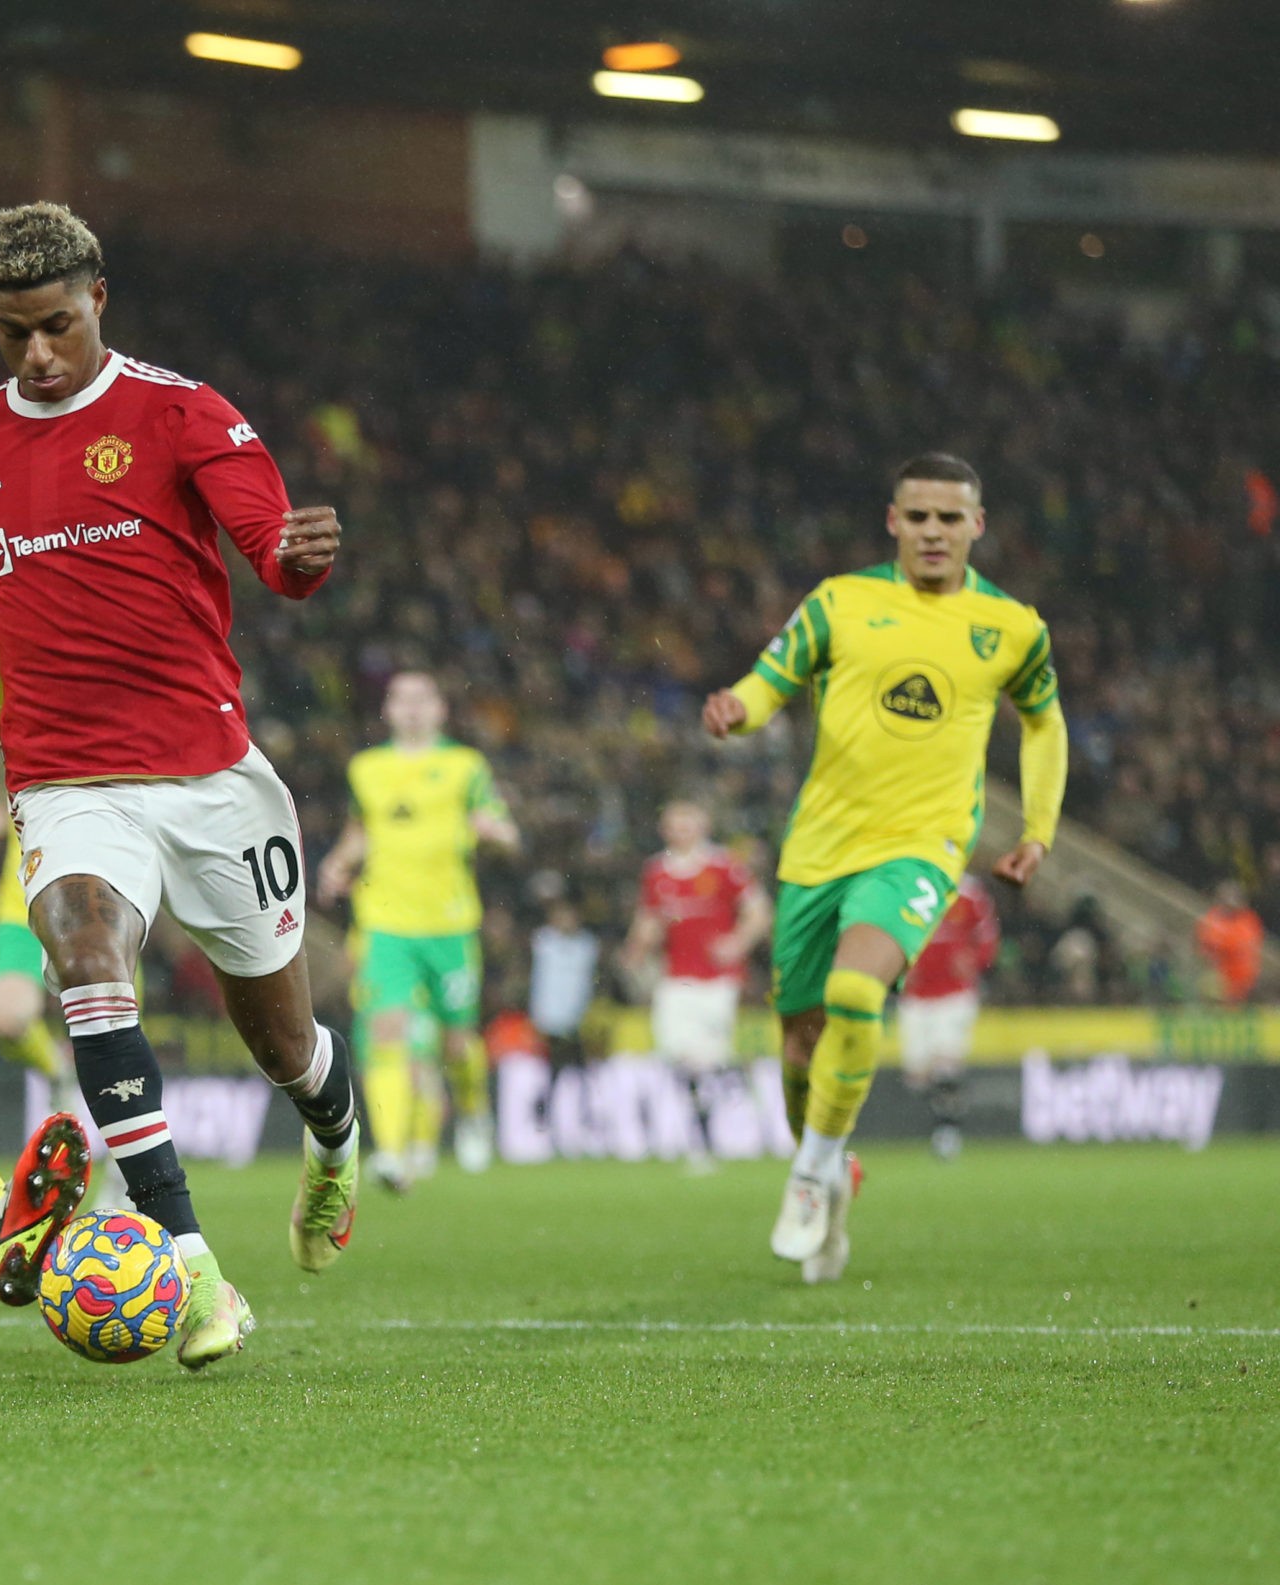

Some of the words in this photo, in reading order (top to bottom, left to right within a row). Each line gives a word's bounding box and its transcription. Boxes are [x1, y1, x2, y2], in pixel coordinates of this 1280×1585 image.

[88, 438, 130, 456] MANCHESTER
[94, 471, 122, 480] UNITED
[9, 518, 142, 557] TeamViewer
[883, 692, 940, 720] LOTUS
[242, 835, 299, 911] 10
[907, 876, 938, 923] 2
[274, 921, 299, 938] adidas
[1023, 1050, 1224, 1152] betway
